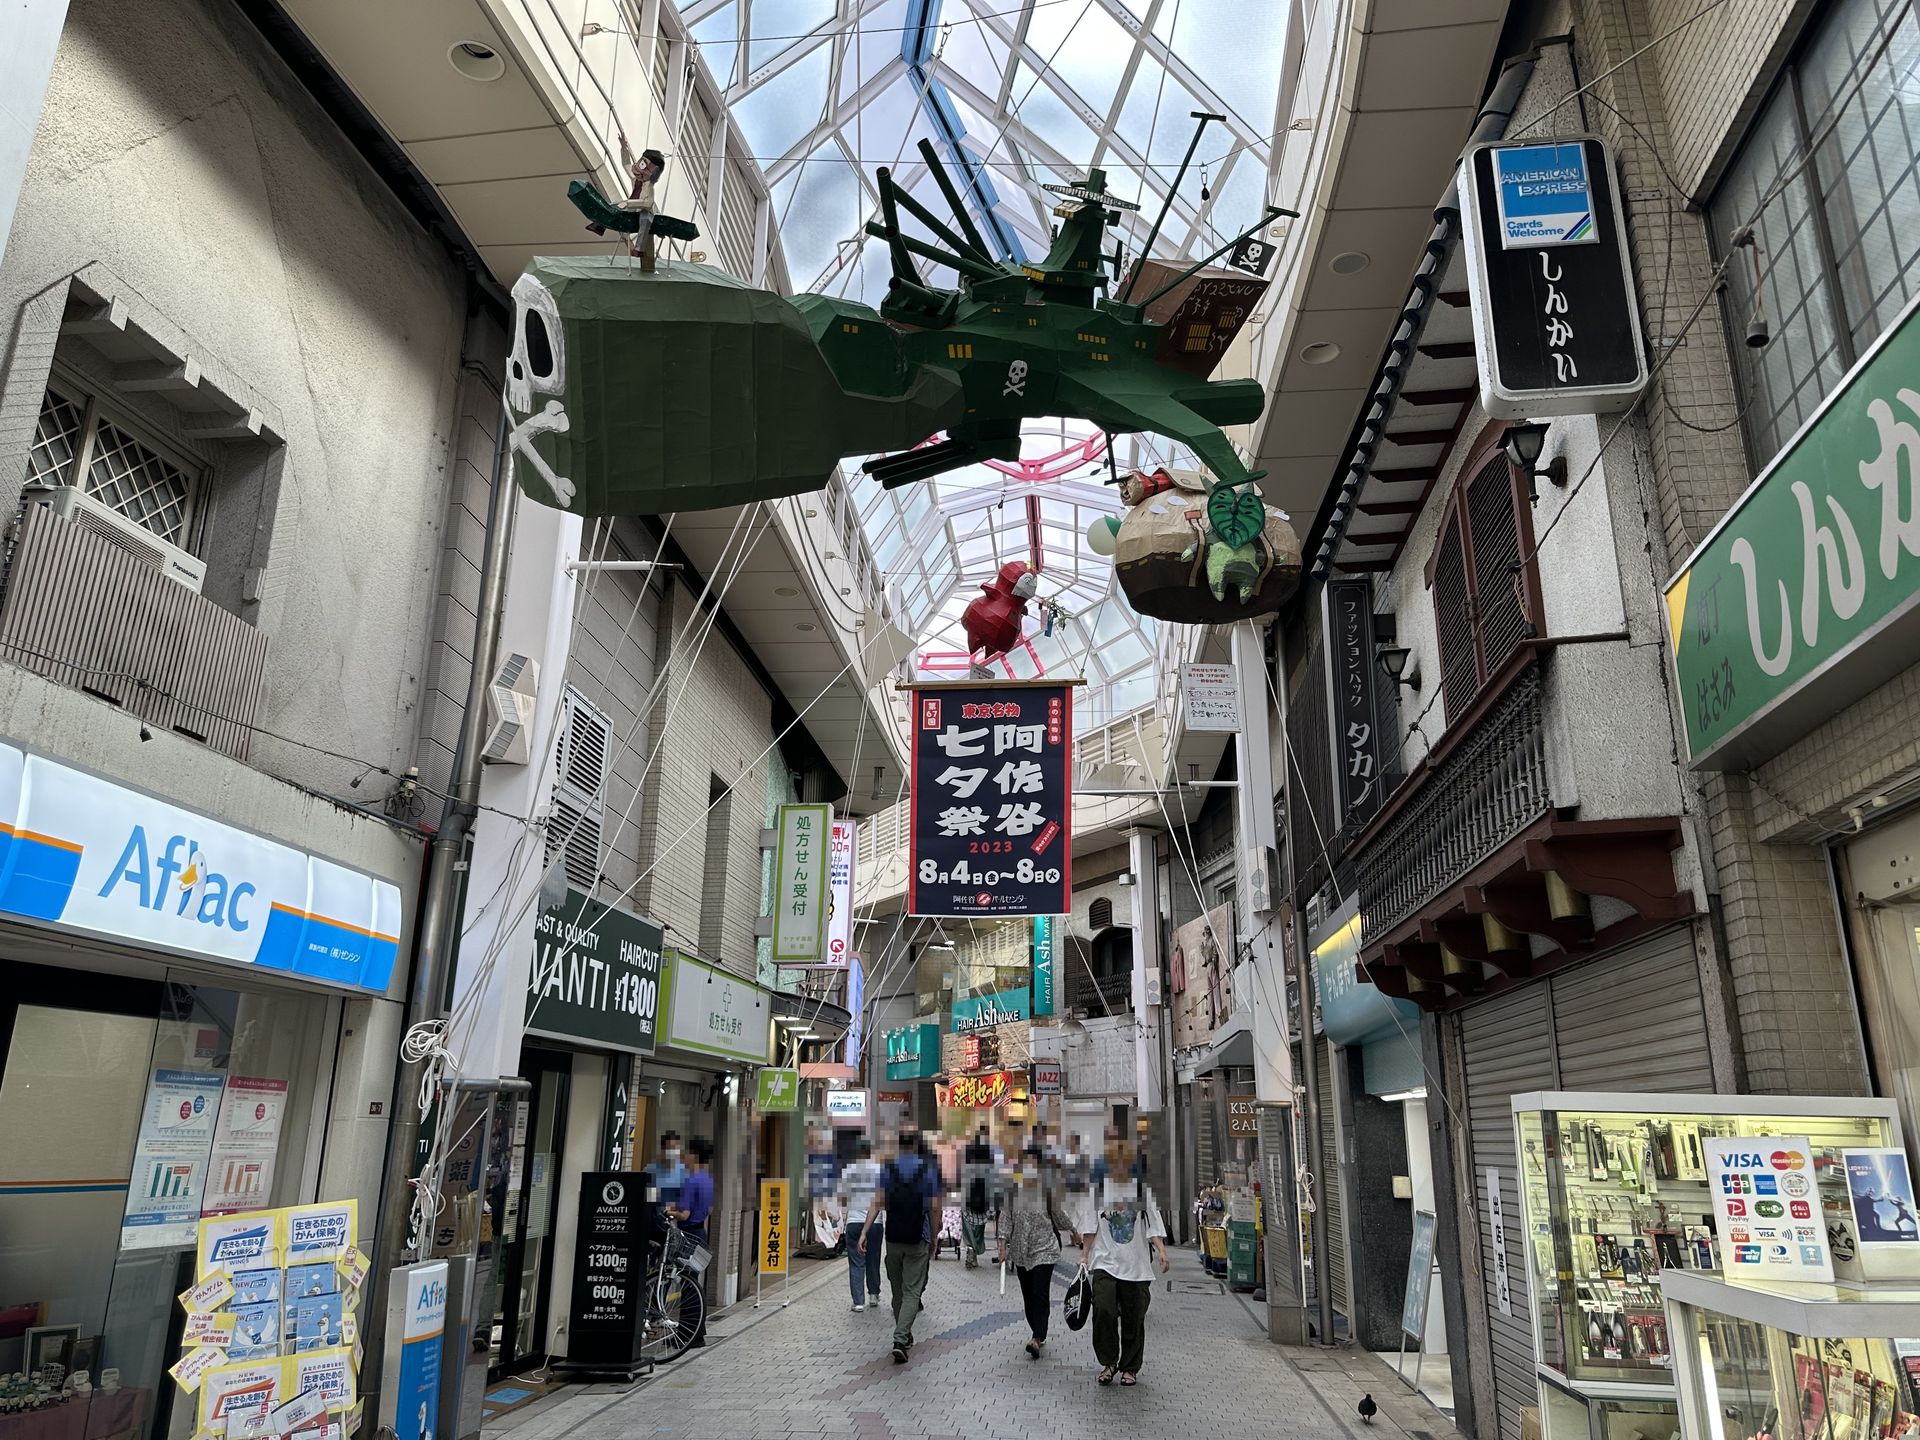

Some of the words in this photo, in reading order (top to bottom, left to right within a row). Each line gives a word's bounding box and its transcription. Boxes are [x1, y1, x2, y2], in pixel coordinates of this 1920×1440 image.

[1501, 168, 1580, 183] AMERICAN
[1519, 181, 1587, 196] EXPRESS
[1506, 219, 1543, 230] Cards
[1507, 226, 1564, 238] Welcome
[1539, 252, 1577, 382] しんかい
[173, 561, 199, 580] Panasonic
[1696, 656, 1736, 734] はさみ
[926, 702, 937, 726] 第67回
[962, 702, 1021, 718] 東京名物
[1347, 721, 1373, 807] タカノ
[935, 724, 990, 837] 七夕祭
[993, 724, 1047, 836] 阿佐谷
[970, 841, 1013, 854] 2023
[792, 815, 811, 916] 処方せん受付
[97, 824, 256, 932] Aflac
[953, 895, 975, 904] 阿佐谷
[992, 894, 1028, 904] パールセンター
[536, 911, 556, 935] AST
[556, 920, 563, 938] &
[565, 923, 600, 950] QUALITY
[620, 939, 659, 973] HAIRCUT
[832, 954, 843, 962] 2F
[1037, 940, 1050, 976] Ash
[615, 971, 656, 1019] ¥1300
[708, 1011, 742, 1037] 処方せん受付
[957, 1018, 974, 1031] HAIR
[974, 1000, 998, 1027] Ash
[998, 1010, 1019, 1023] MAKE
[1037, 1071, 1058, 1082] JAZZ
[1718, 1153, 1764, 1168] VISA
[1721, 1180, 1750, 1188] JCB
[295, 1217, 344, 1231] 生きるための
[767, 1196, 780, 1267] せん受付
[295, 1227, 336, 1241] がん保険
[588, 1253, 627, 1267] 1300円
[593, 1285, 625, 1299] 600円
[304, 1370, 344, 1384] 生きるための
